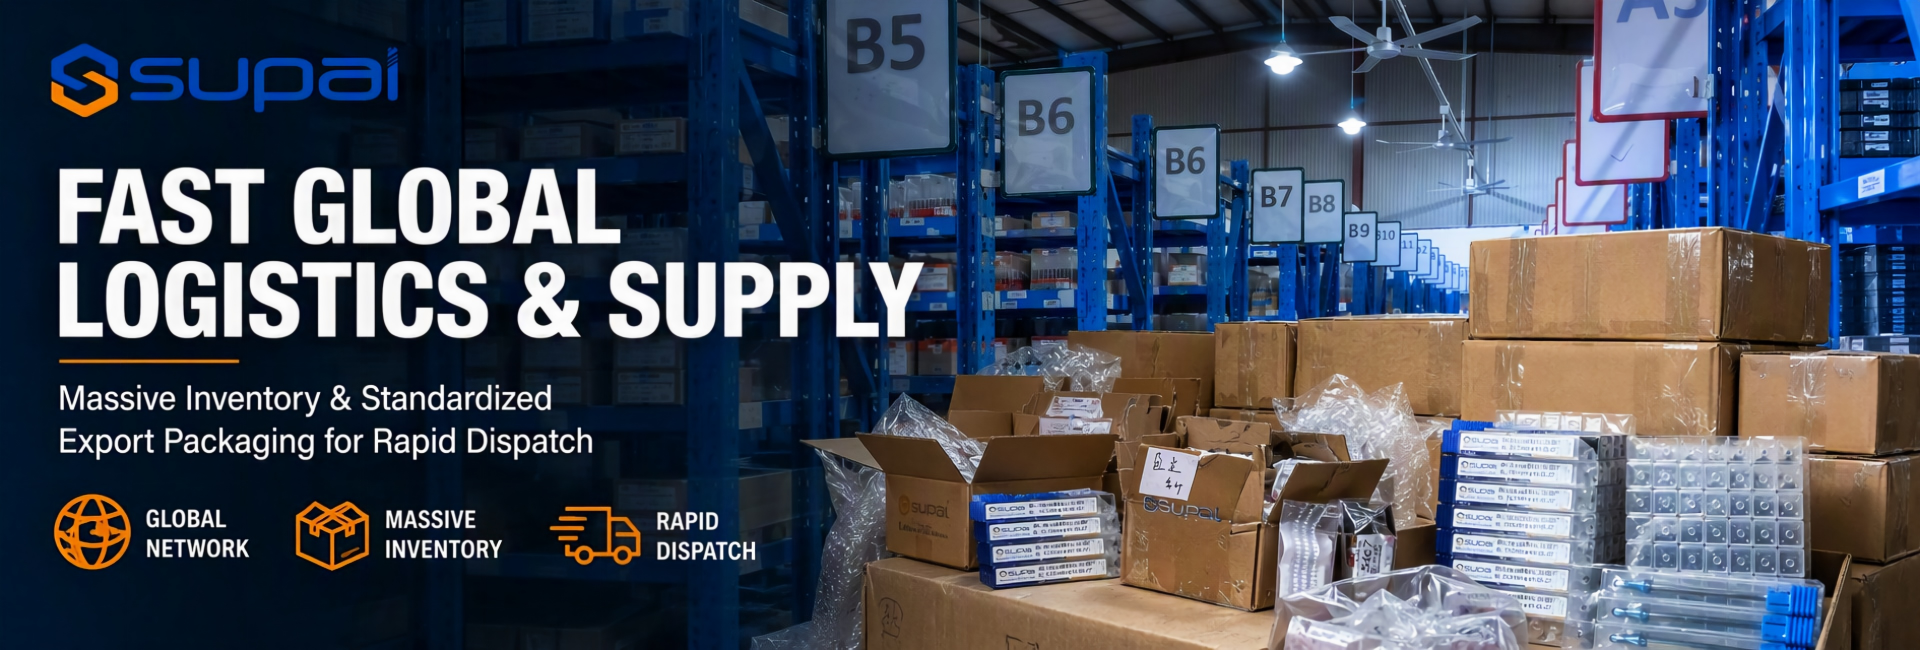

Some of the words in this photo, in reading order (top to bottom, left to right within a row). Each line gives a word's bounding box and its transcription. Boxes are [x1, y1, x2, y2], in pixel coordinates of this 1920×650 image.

[846, 14, 926, 74] B5
[1018, 97, 1075, 137] B6
[1165, 146, 1206, 175] B6
[1261, 185, 1293, 208] B7
[1308, 195, 1335, 214] B8
[1349, 223, 1370, 238] B9
